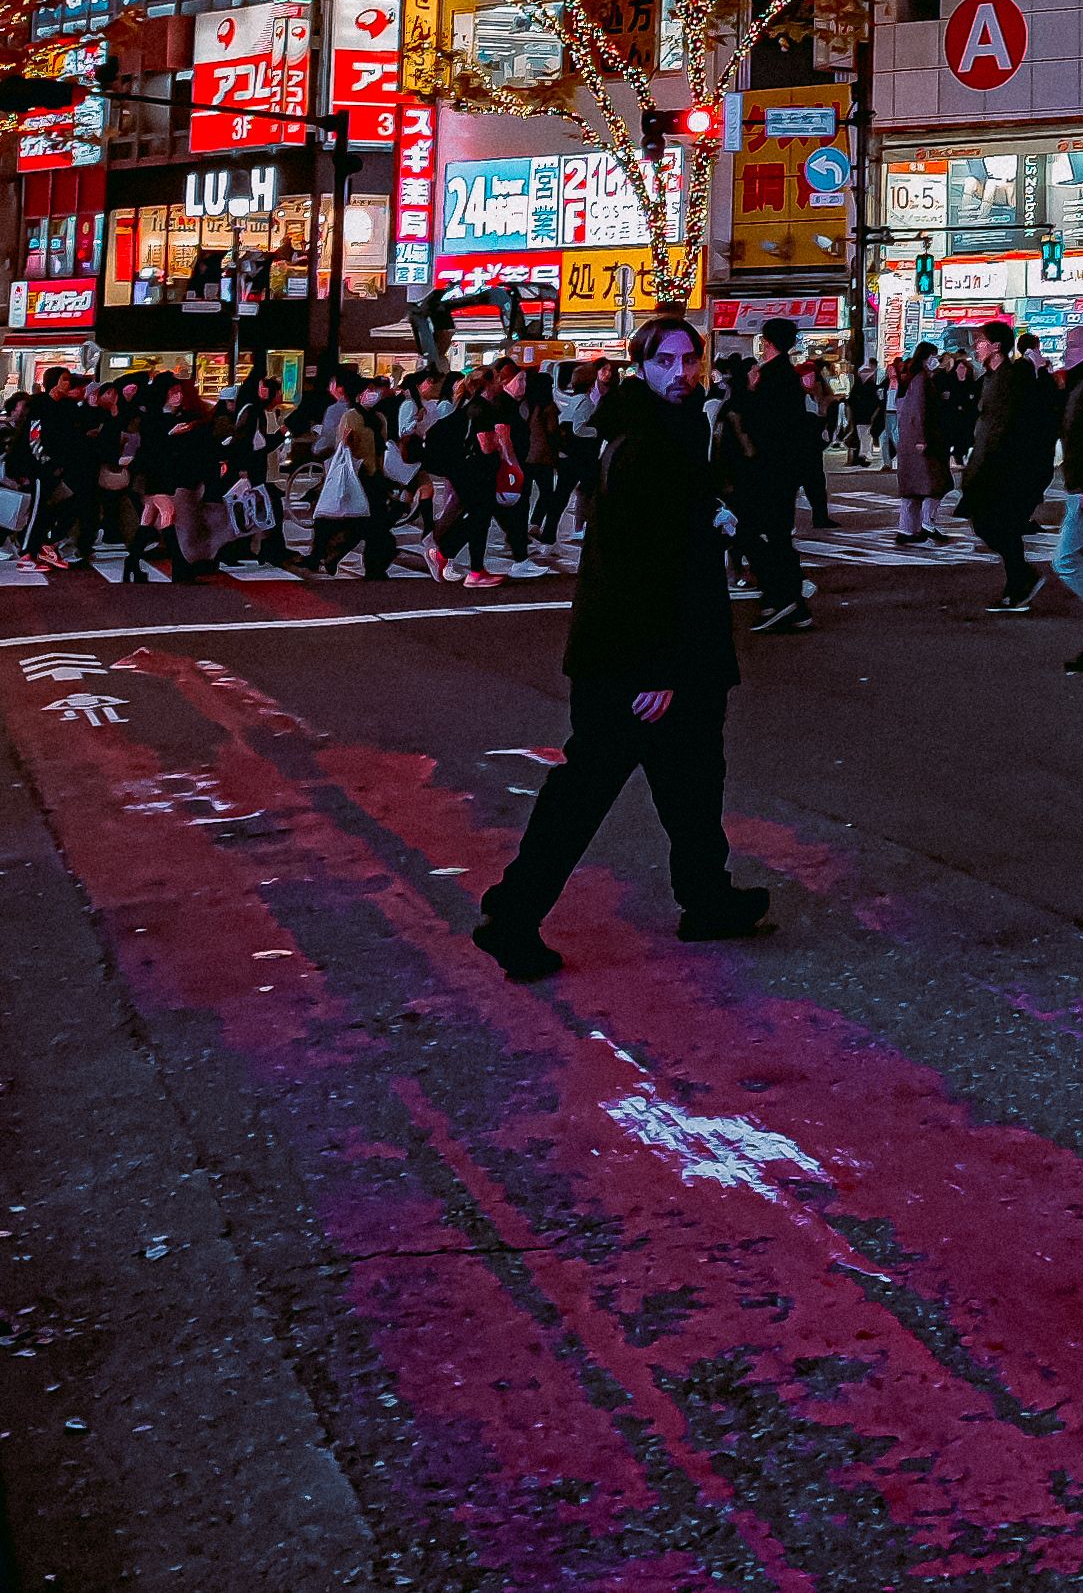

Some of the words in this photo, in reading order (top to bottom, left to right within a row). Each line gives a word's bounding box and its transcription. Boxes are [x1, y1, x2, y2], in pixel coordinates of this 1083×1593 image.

[957, 3, 1013, 74] A
[232, 114, 254, 140] 3F
[400, 108, 432, 238] スギ薬局
